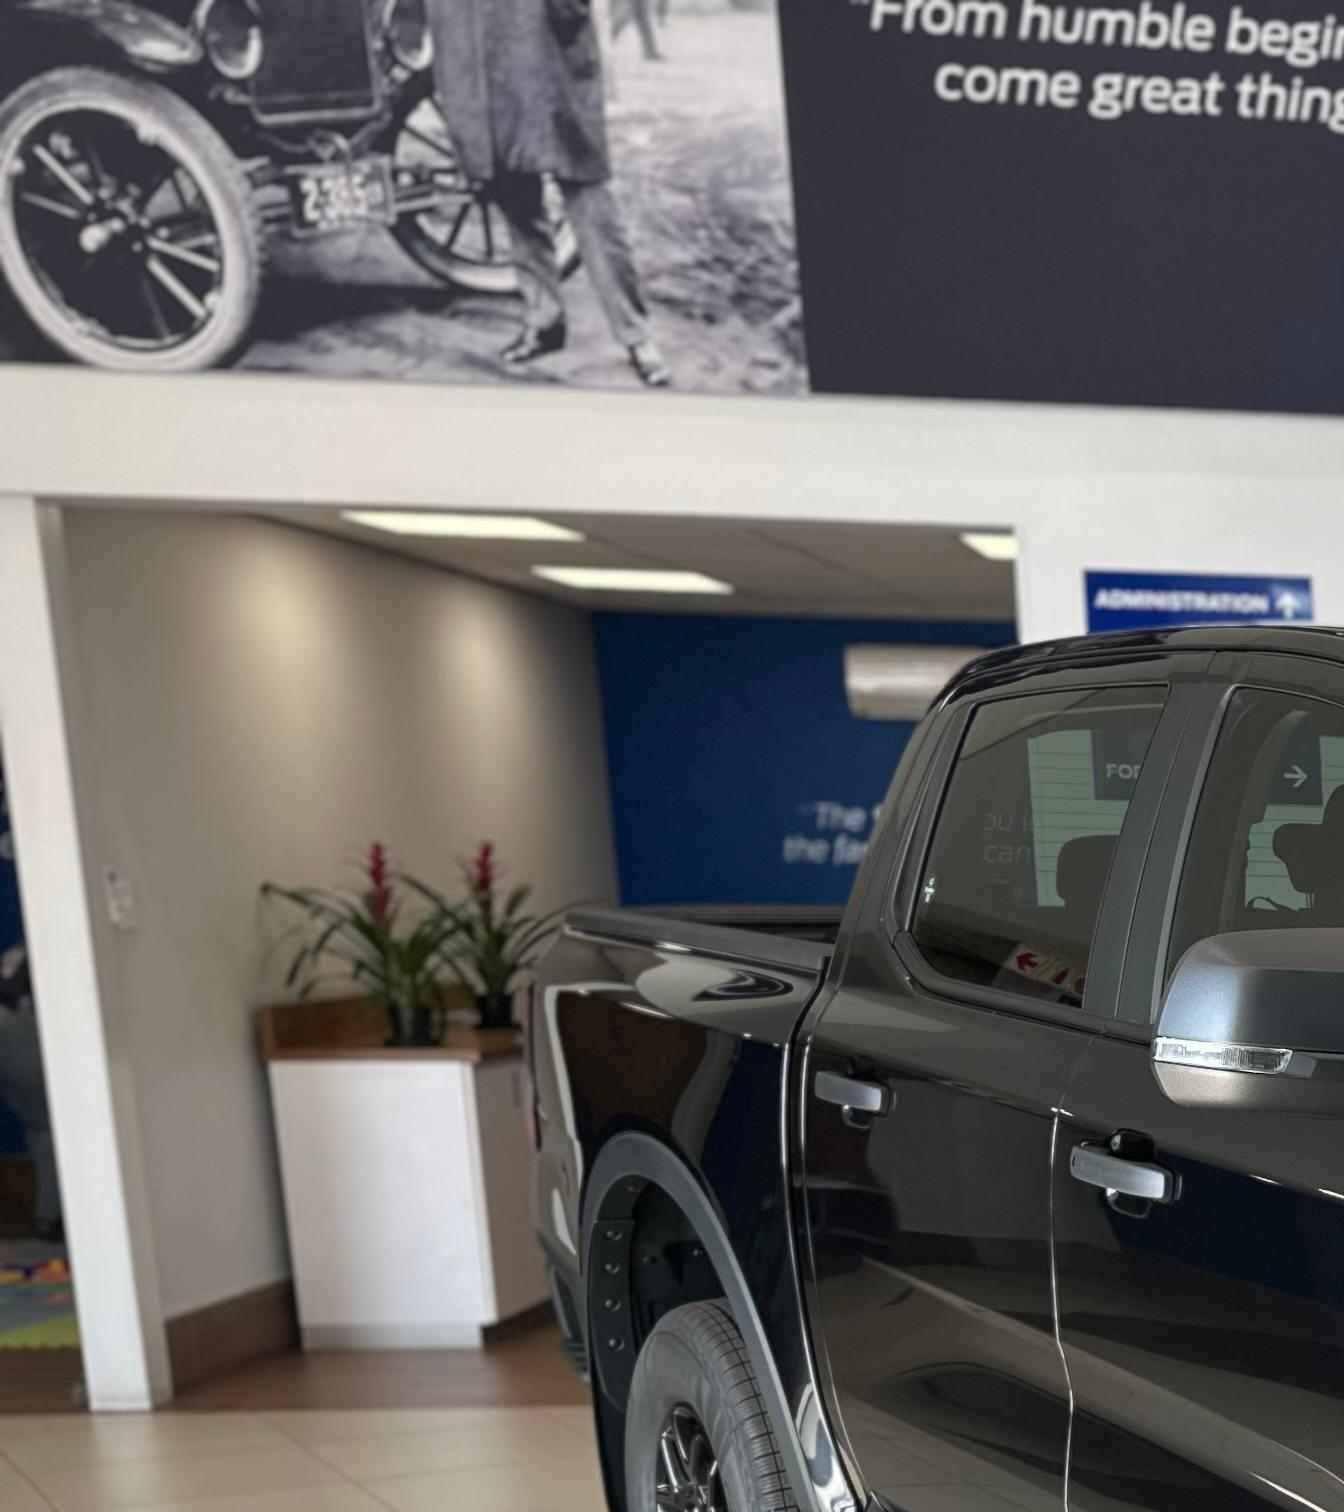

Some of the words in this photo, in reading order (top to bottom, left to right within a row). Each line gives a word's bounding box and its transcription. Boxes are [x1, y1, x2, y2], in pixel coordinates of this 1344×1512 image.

[1018, 0, 1216, 51] humble
[934, 62, 1081, 108] come
[1088, 71, 1226, 119] great
[1094, 588, 1270, 614] ADMINISTRATION
